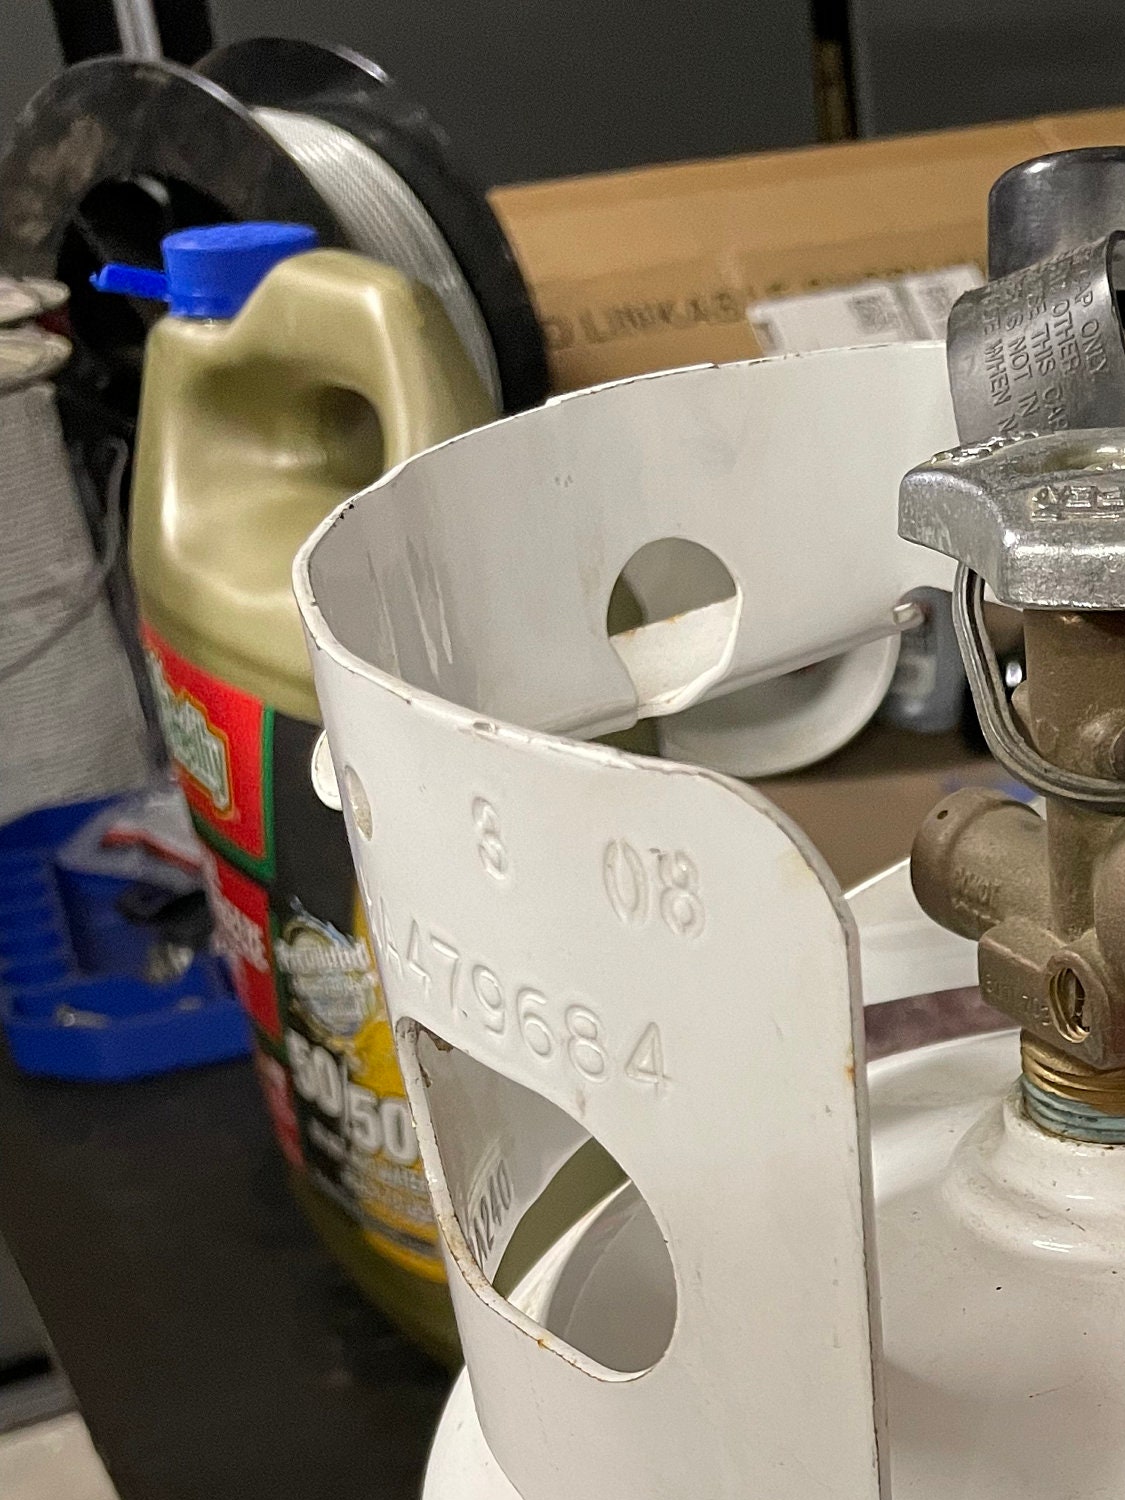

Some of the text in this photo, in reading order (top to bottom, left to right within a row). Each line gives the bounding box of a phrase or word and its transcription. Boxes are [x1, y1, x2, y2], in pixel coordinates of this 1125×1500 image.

[986, 339, 1012, 407] WHEN
[1053, 299, 1081, 373] OTHER
[1007, 336, 1039, 417] NOT IN
[1031, 323, 1068, 429] THIS CAP
